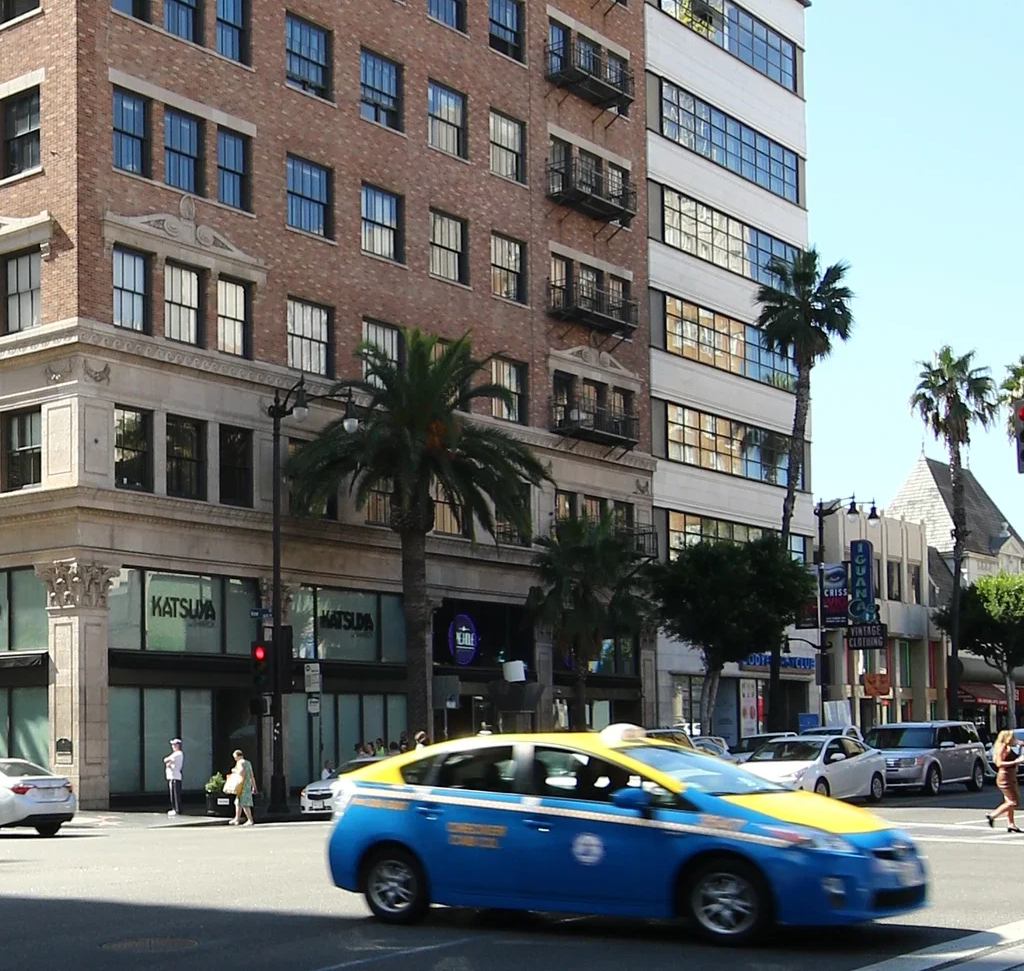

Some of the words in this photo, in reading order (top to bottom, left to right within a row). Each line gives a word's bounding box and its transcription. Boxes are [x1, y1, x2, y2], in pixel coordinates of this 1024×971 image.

[855, 542, 867, 611] IGUANA
[824, 588, 848, 597] CRISS
[151, 595, 216, 620] KATSUYA
[319, 610, 373, 632] KATSUYA
[851, 625, 881, 637] VINTAGE
[849, 636, 883, 648] CLOTHING
